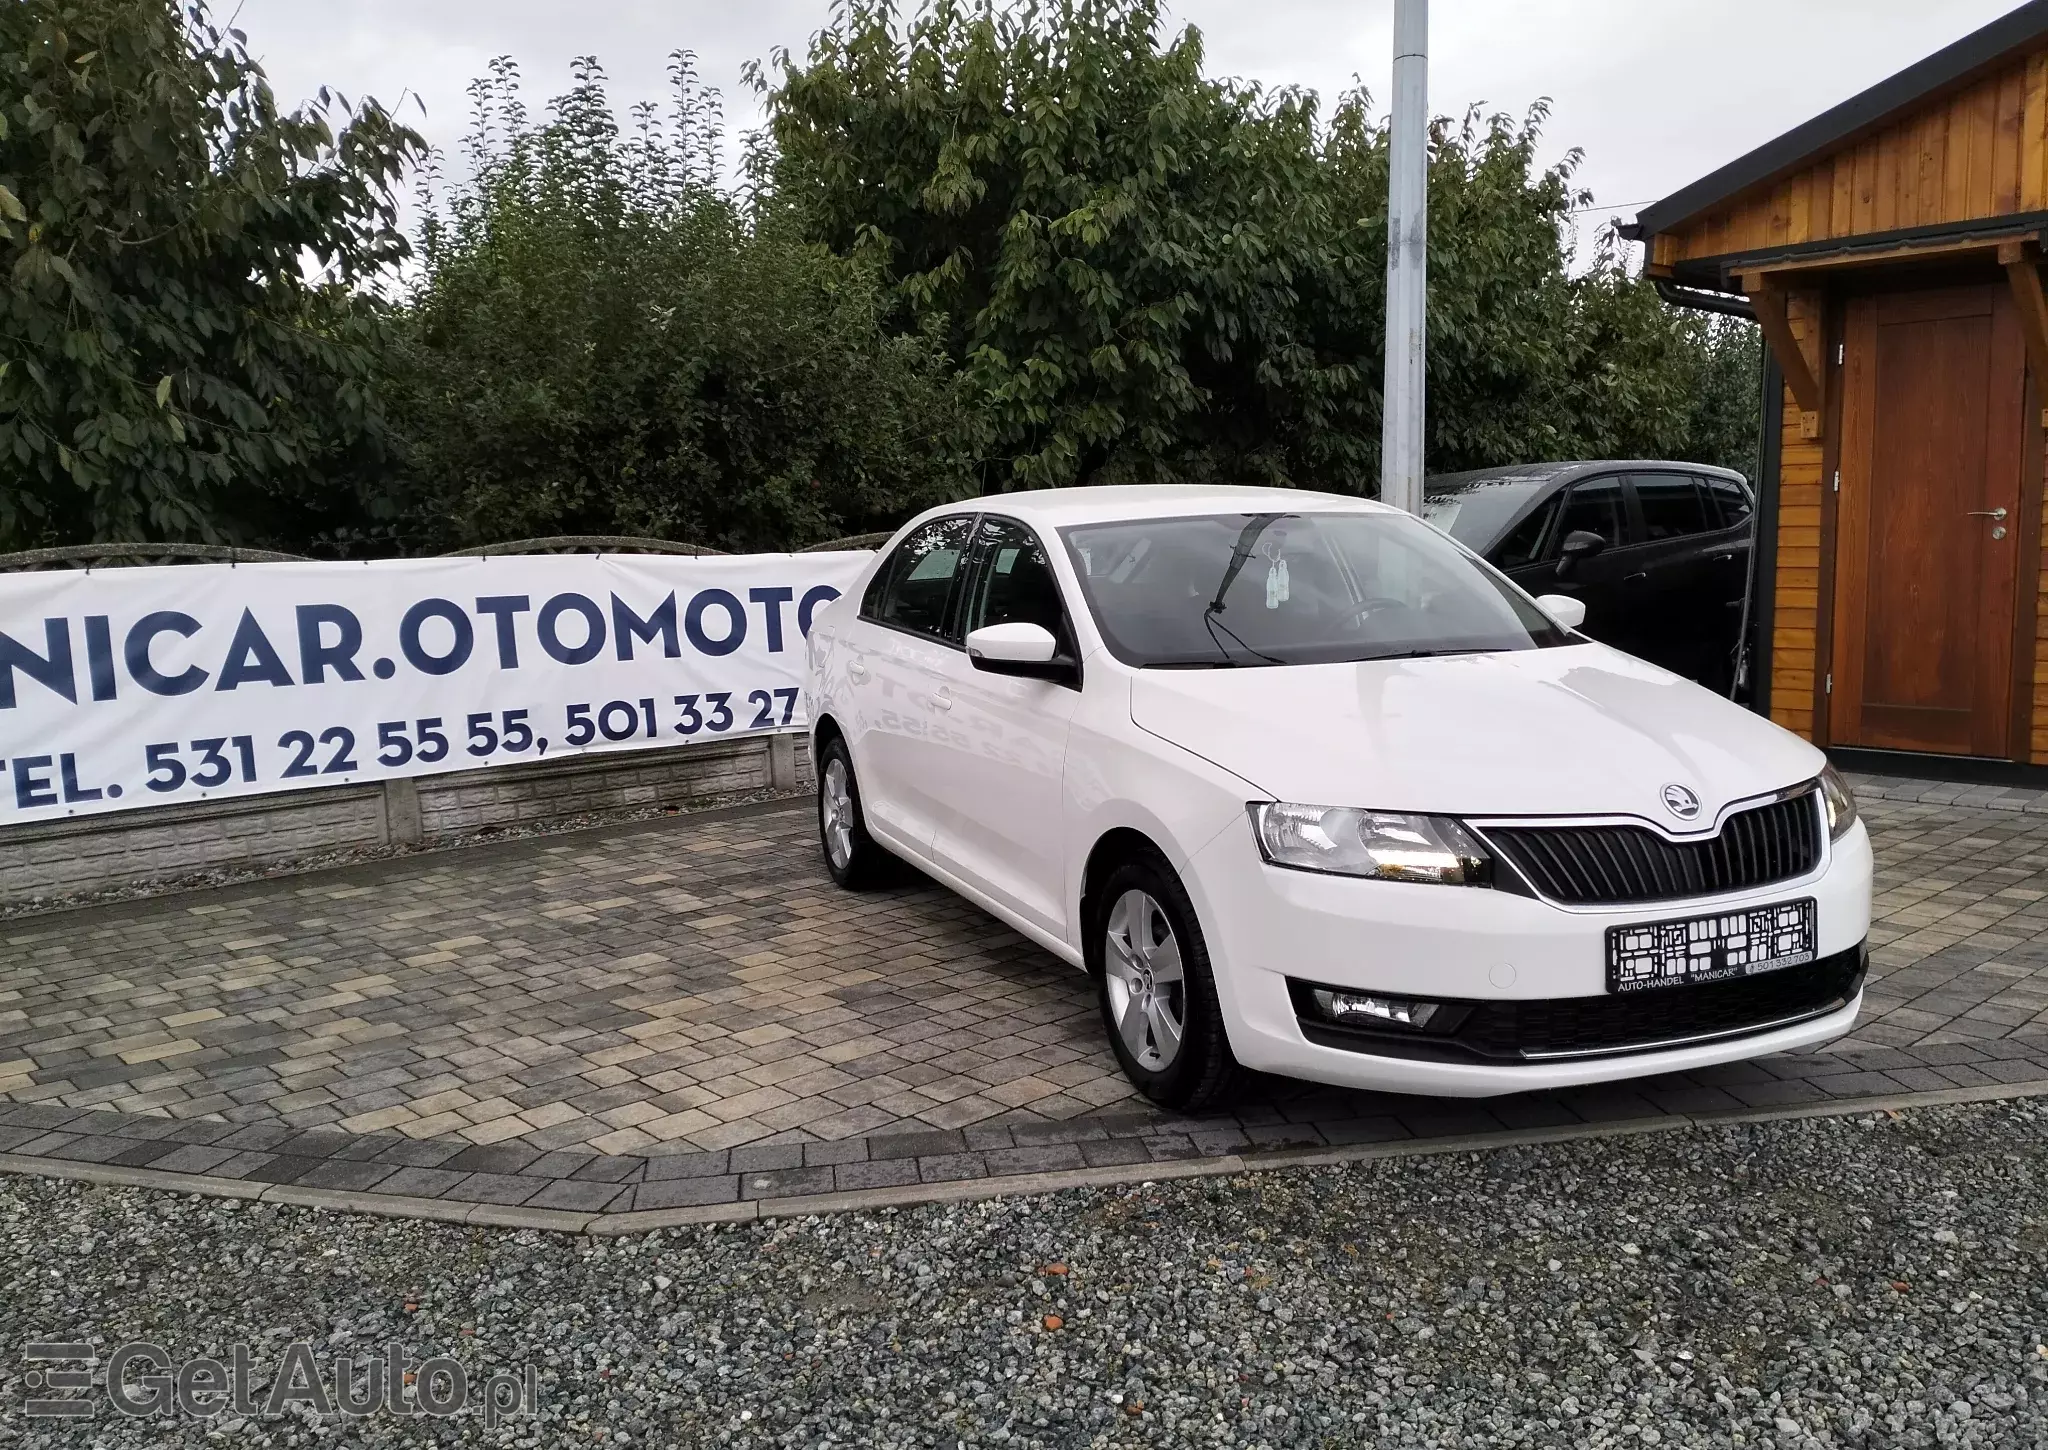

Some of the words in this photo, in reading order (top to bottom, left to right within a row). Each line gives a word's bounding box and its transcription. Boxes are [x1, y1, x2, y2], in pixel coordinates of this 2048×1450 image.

[0, 753, 123, 809] EL.
[146, 734, 257, 793] 531
[277, 726, 358, 779] 22
[378, 717, 450, 767] 55
[467, 709, 549, 757] 55,
[565, 698, 658, 746] 501
[674, 692, 734, 735] 33
[749, 688, 800, 728] 27
[1617, 976, 1685, 993] AUTO-HANDEL
[1690, 967, 1738, 982] "MANICAR"
[1757, 961, 1777, 971] 501
